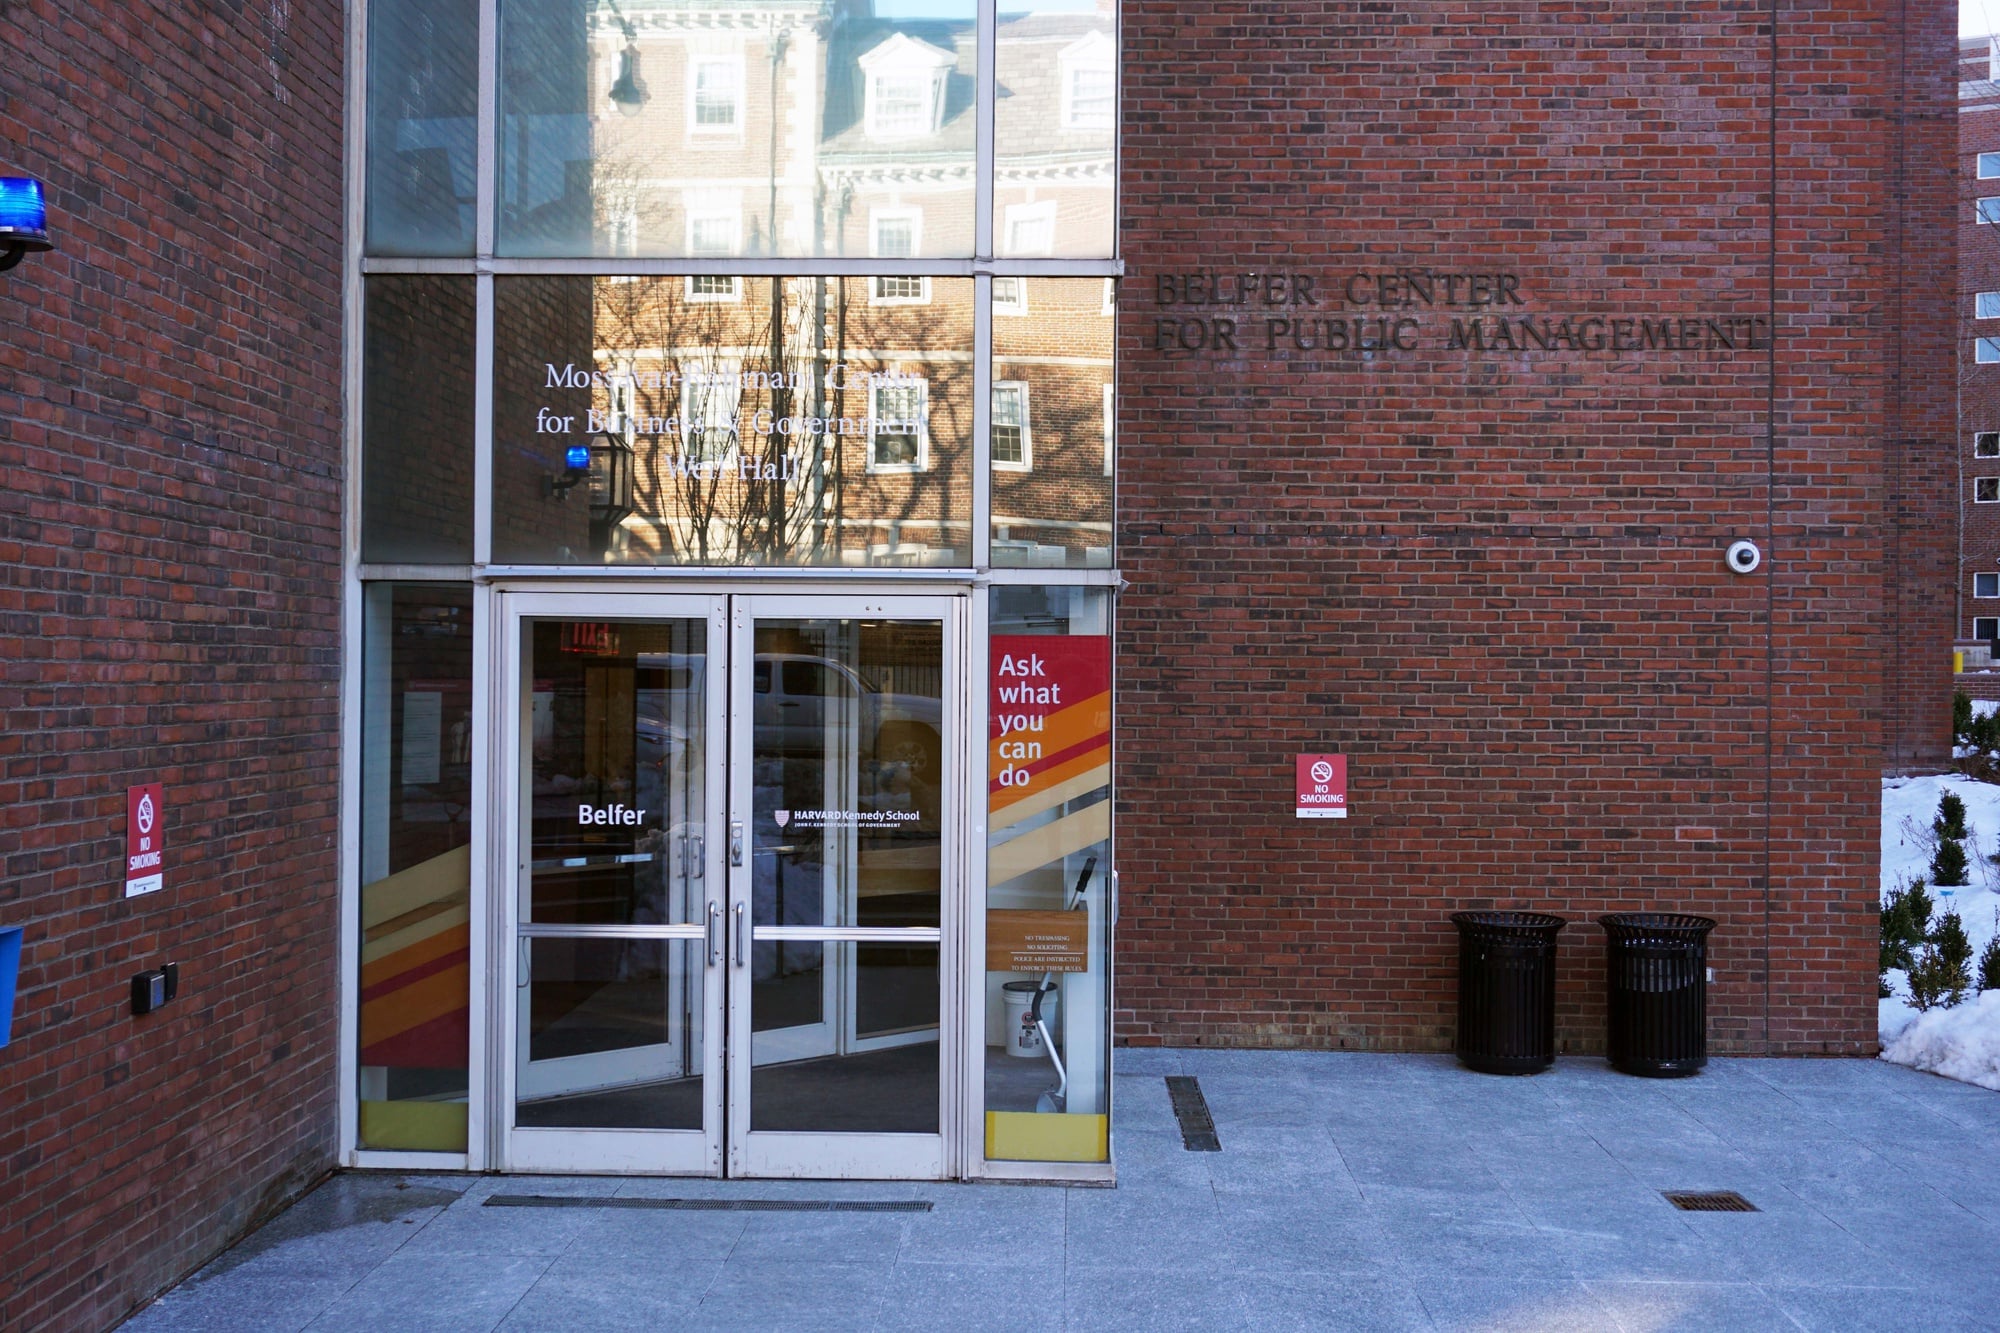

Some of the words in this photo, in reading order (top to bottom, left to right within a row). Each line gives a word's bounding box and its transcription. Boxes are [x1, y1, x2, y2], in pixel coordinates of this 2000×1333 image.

[1155, 273, 1319, 306] BELFER
[1346, 272, 1525, 306] CENTER
[1154, 317, 1238, 351] FOR
[1265, 317, 1419, 351] PUBLIC
[1447, 317, 1765, 351] MANAGEMENT
[828, 363, 922, 390] Center
[536, 406, 574, 434] for
[586, 408, 704, 434] Business
[752, 408, 926, 435] Government
[664, 453, 725, 480] Weil
[738, 453, 801, 481] Hall
[998, 653, 1046, 677] Ask
[998, 681, 1061, 704] what
[999, 714, 1044, 737] you
[999, 741, 1042, 759] can
[998, 763, 1030, 787] do
[1301, 795, 1343, 803] SMOKING
[1315, 785, 1328, 793] NO
[578, 803, 646, 826] Belfer
[794, 810, 841, 820] HARVARD
[842, 810, 885, 823] Kennedy
[885, 810, 920, 821] School
[140, 837, 150, 851] NO
[130, 851, 160, 870] SMOKING
